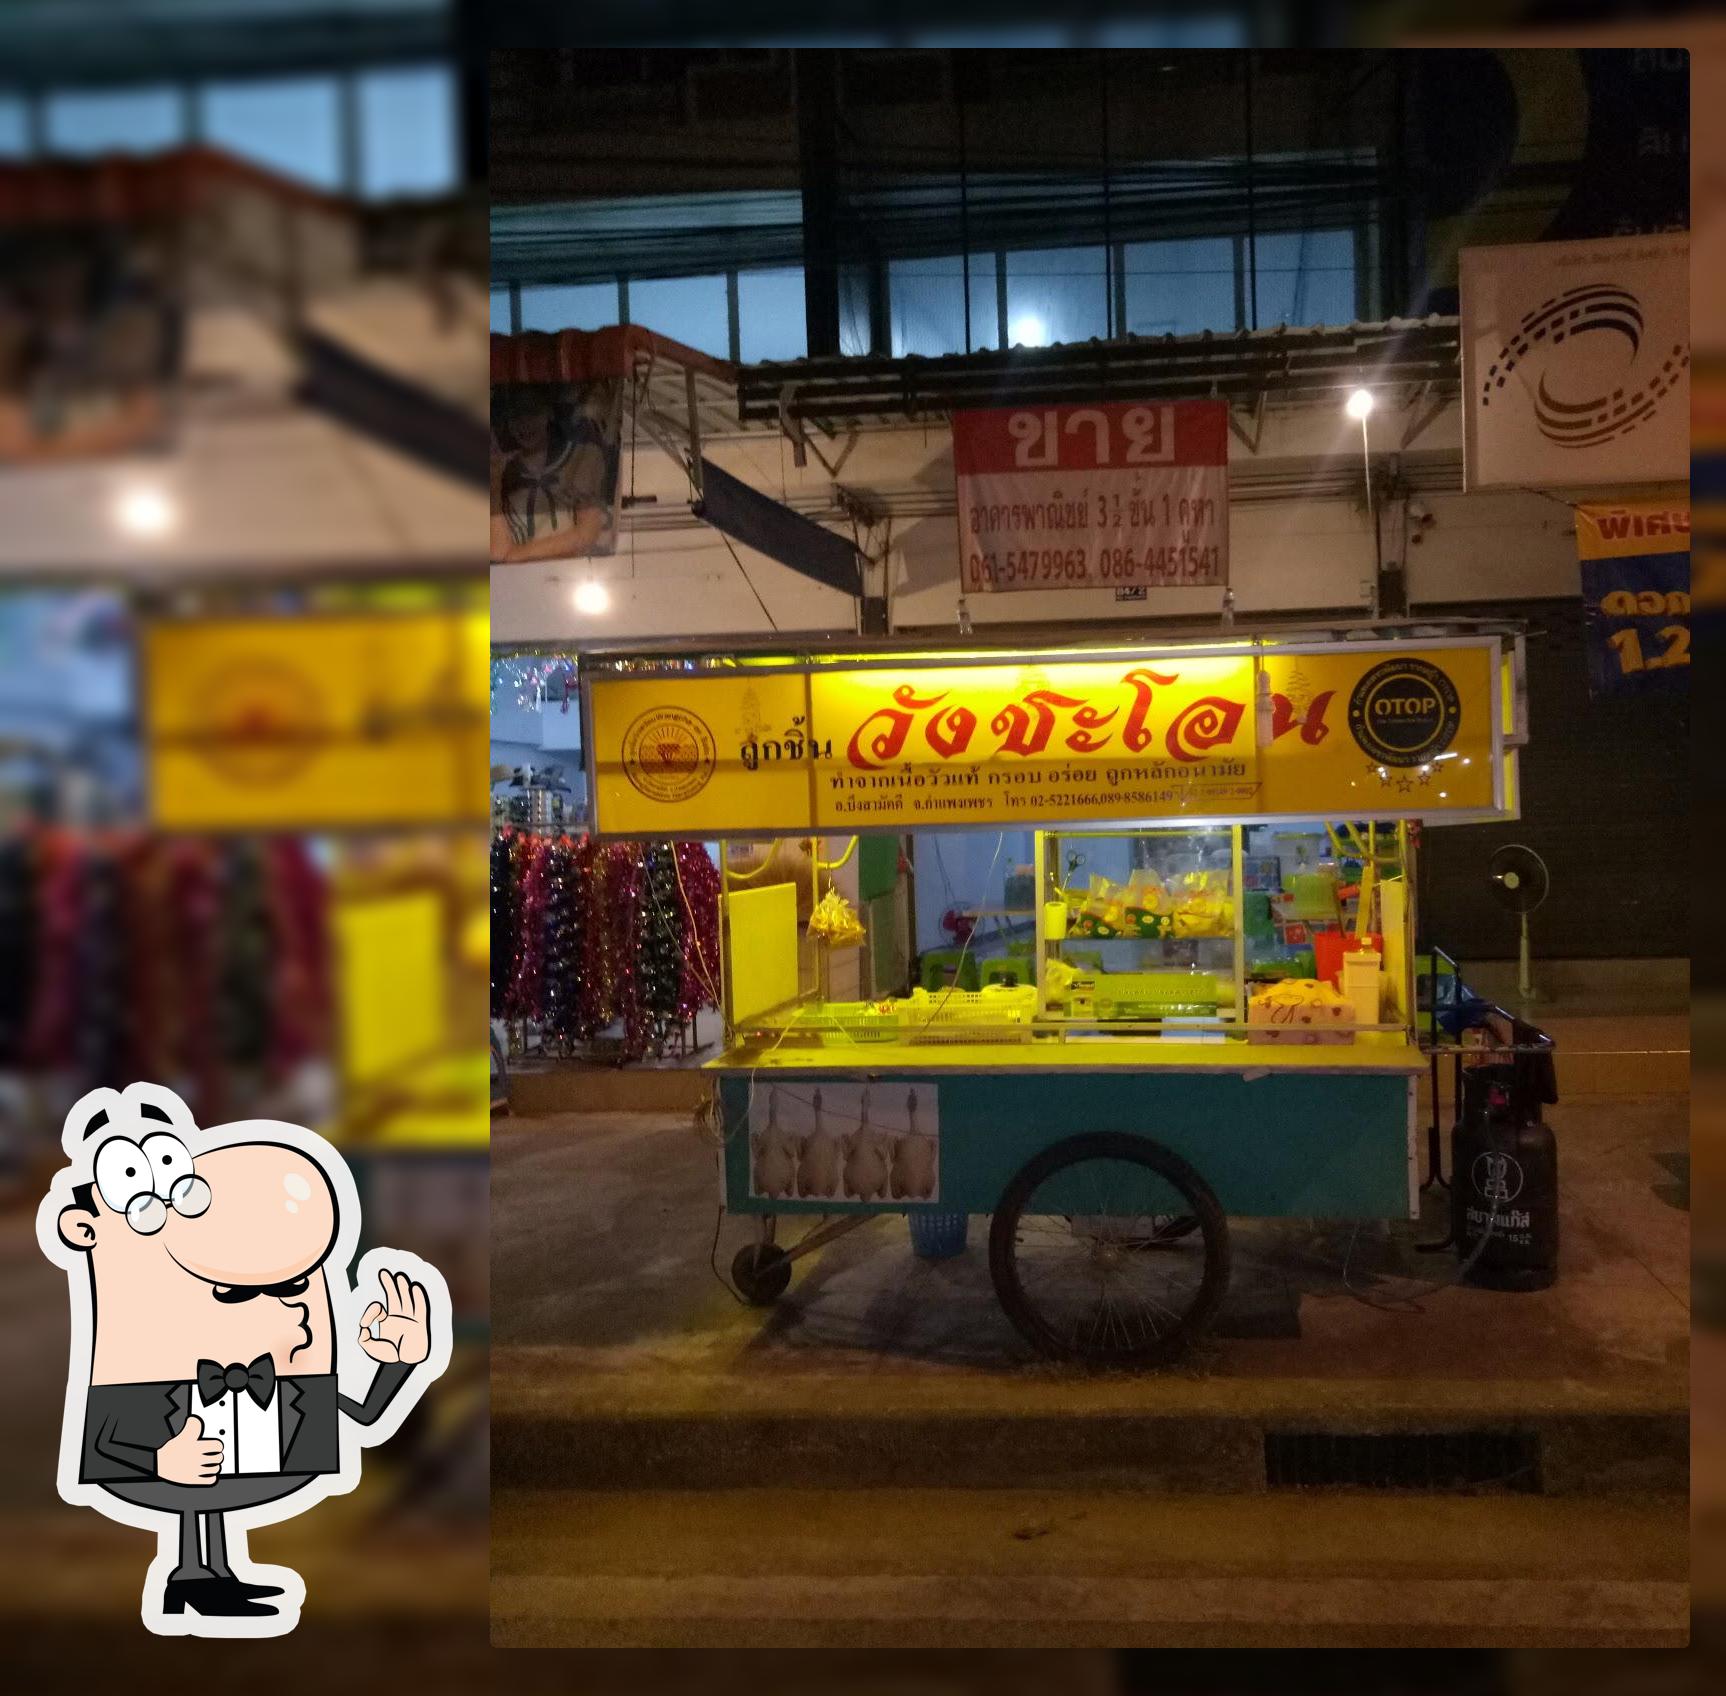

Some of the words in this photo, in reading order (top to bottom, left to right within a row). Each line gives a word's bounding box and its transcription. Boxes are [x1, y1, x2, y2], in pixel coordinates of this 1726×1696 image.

[1008, 406, 1175, 466] ขาย
[971, 489, 1088, 534] อาคารพาณิชย์
[1101, 545, 1219, 579] 086-4451541
[846, 668, 1337, 770] วังชะโอน
[1374, 697, 1437, 715] OTOP
[988, 769, 1042, 785] กรอบ
[1048, 763, 1097, 784] อร่อย
[1105, 757, 1247, 787] ถูกหลักอนามัย
